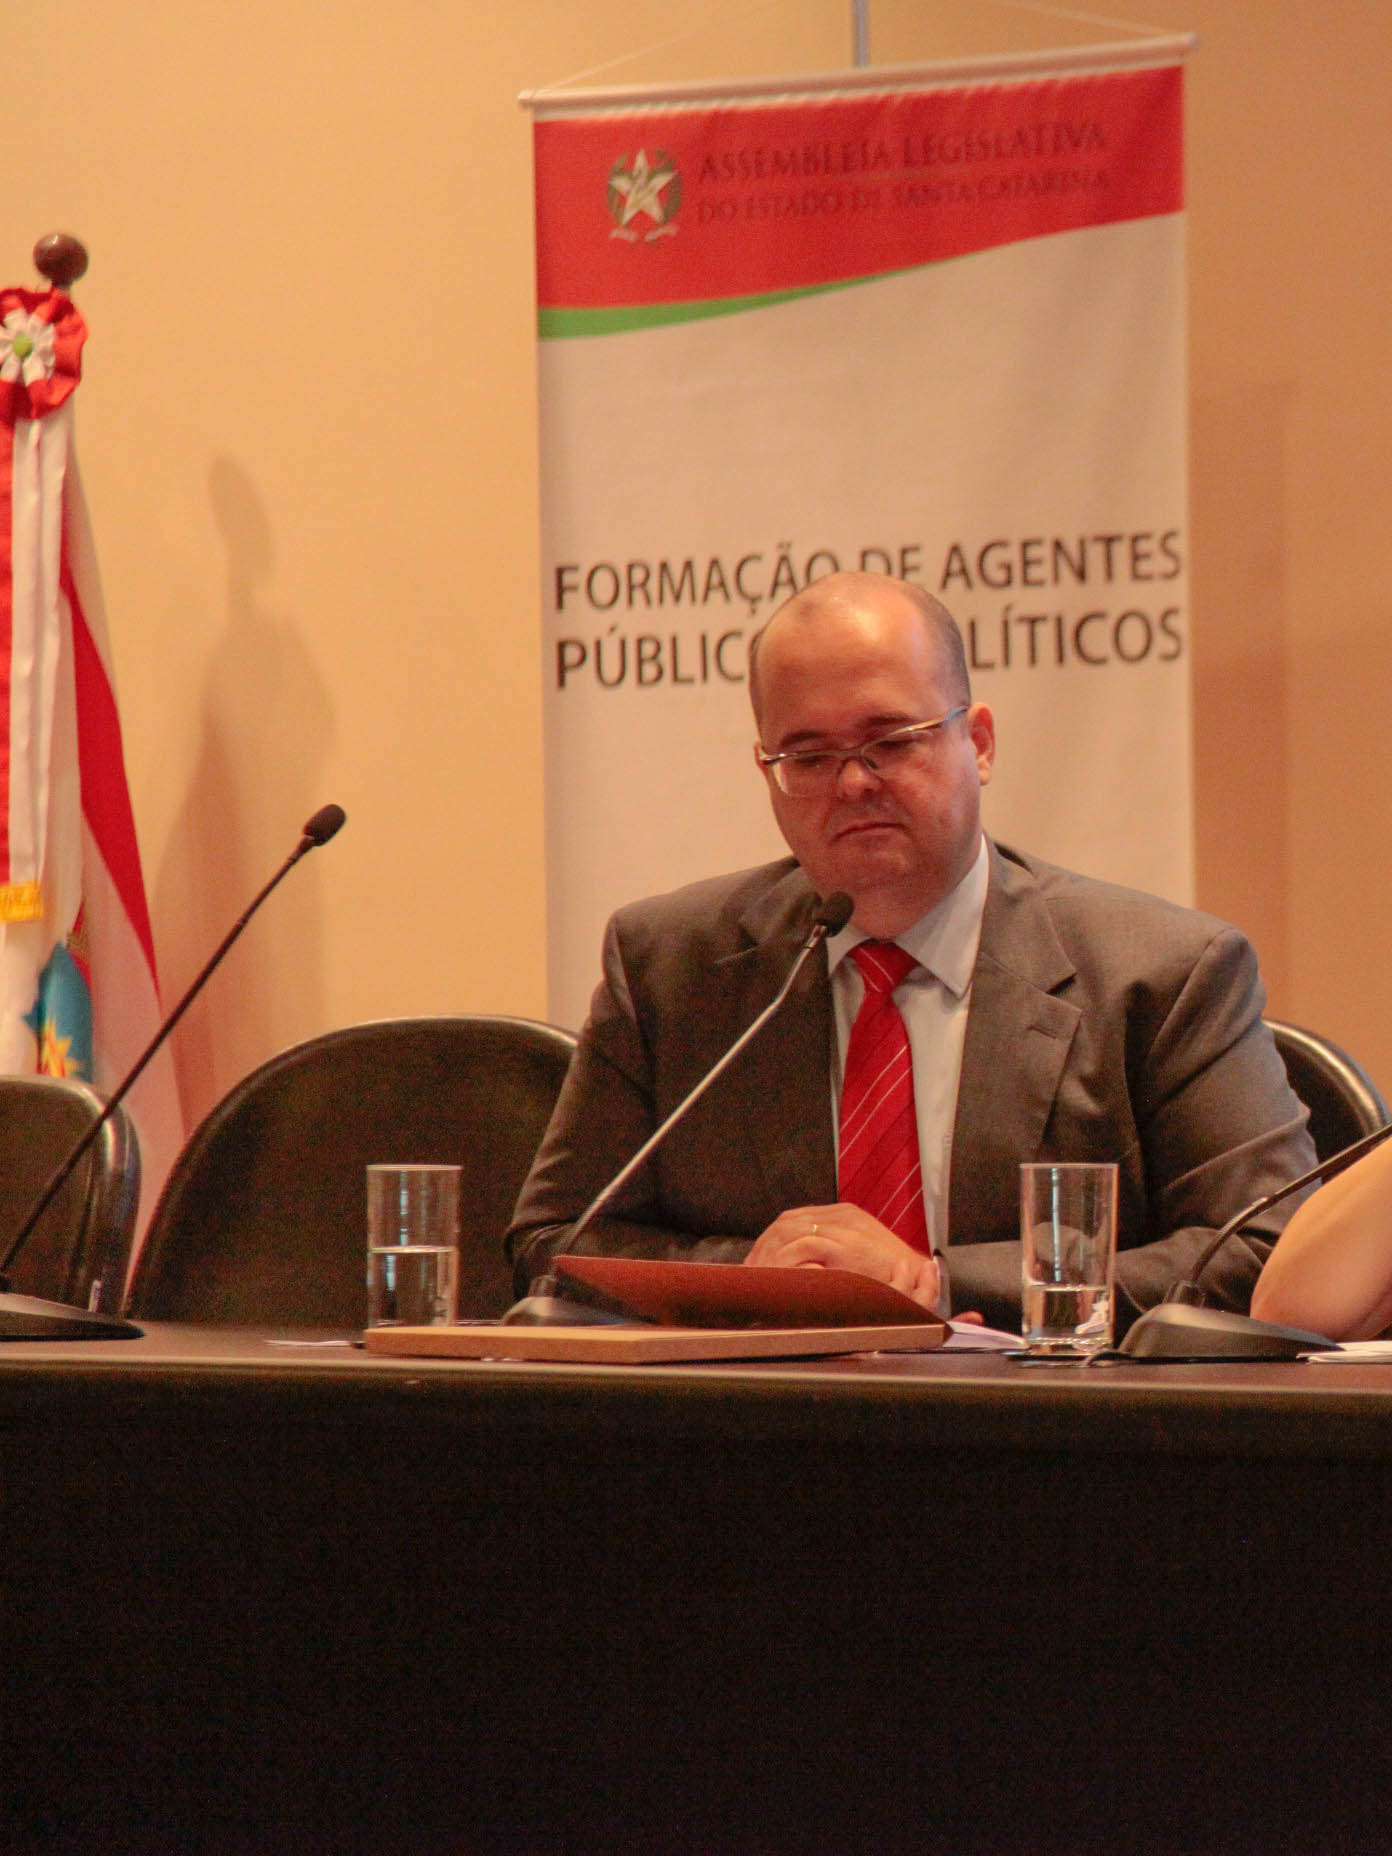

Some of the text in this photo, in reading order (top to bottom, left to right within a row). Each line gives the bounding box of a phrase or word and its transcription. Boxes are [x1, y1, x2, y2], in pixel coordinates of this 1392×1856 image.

[698, 122, 1107, 182] ASSEMBLEIA LEGISLATIVA
[696, 196, 738, 224] DO
[746, 189, 845, 219] ESTADO
[940, 530, 1182, 591] AGENTES
[555, 603, 1182, 691] PÚBLIC LÍTICOS
